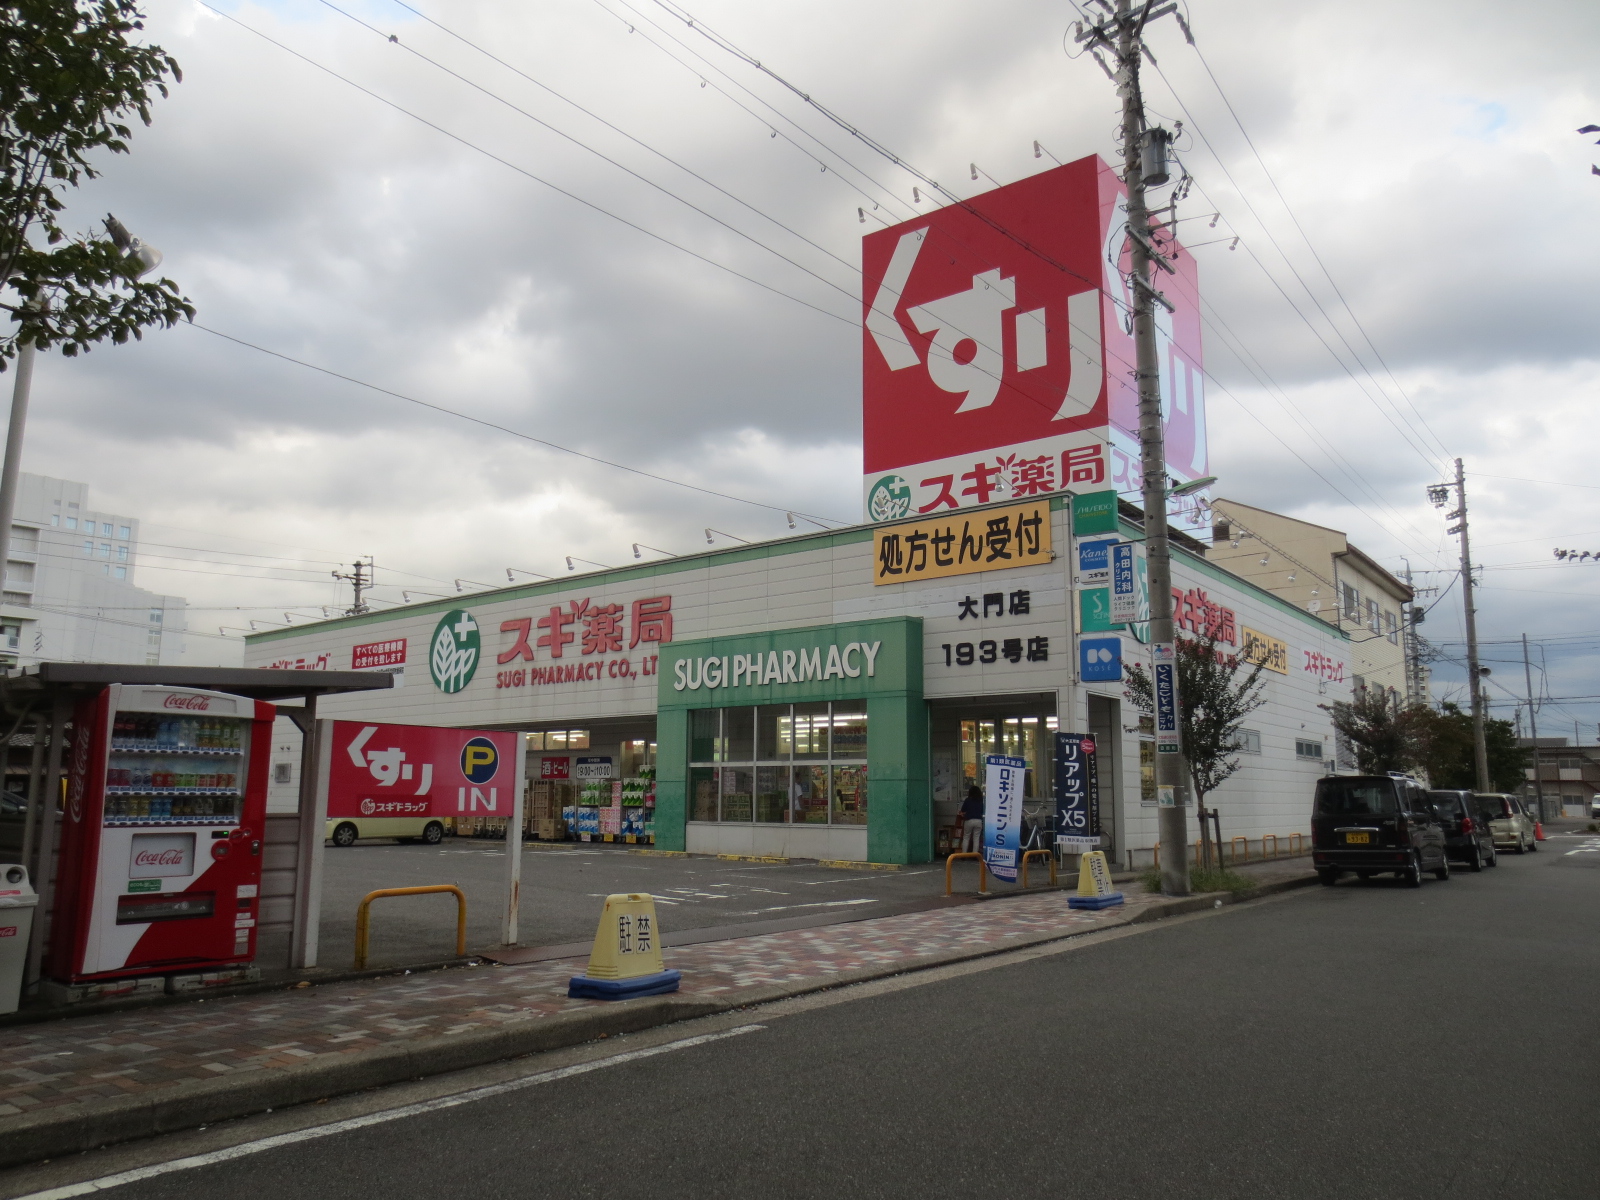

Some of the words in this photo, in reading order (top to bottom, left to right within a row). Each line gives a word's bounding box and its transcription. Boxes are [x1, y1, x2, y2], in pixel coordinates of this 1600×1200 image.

[865, 226, 1102, 421] くすり
[919, 443, 1106, 513] スギ薬局
[1075, 503, 1112, 514] SHISEIDO
[880, 510, 1042, 577] 処方せん受付
[1080, 549, 1108, 558] Kane
[1120, 547, 1132, 592] 高田内科
[958, 589, 1030, 620] 大門店
[1171, 588, 1237, 646] スギ薬局
[497, 595, 672, 664] スギ薬局
[356, 641, 403, 656] すべての医療機関
[942, 636, 1048, 666] 193号店
[497, 668, 525, 689] SUGI
[531, 660, 604, 685] PHARMACY
[674, 655, 728, 691] SUGI
[733, 641, 881, 688] PHARMACY
[1303, 651, 1344, 683] スギドラッグ
[163, 694, 211, 711] Coca-Cola
[1157, 665, 1172, 713] いくたこども
[347, 726, 433, 795] くすり
[465, 745, 495, 775] P
[376, 802, 428, 811] スギドラッグ
[458, 787, 497, 811] IN
[135, 849, 185, 866] Coca-Cola
